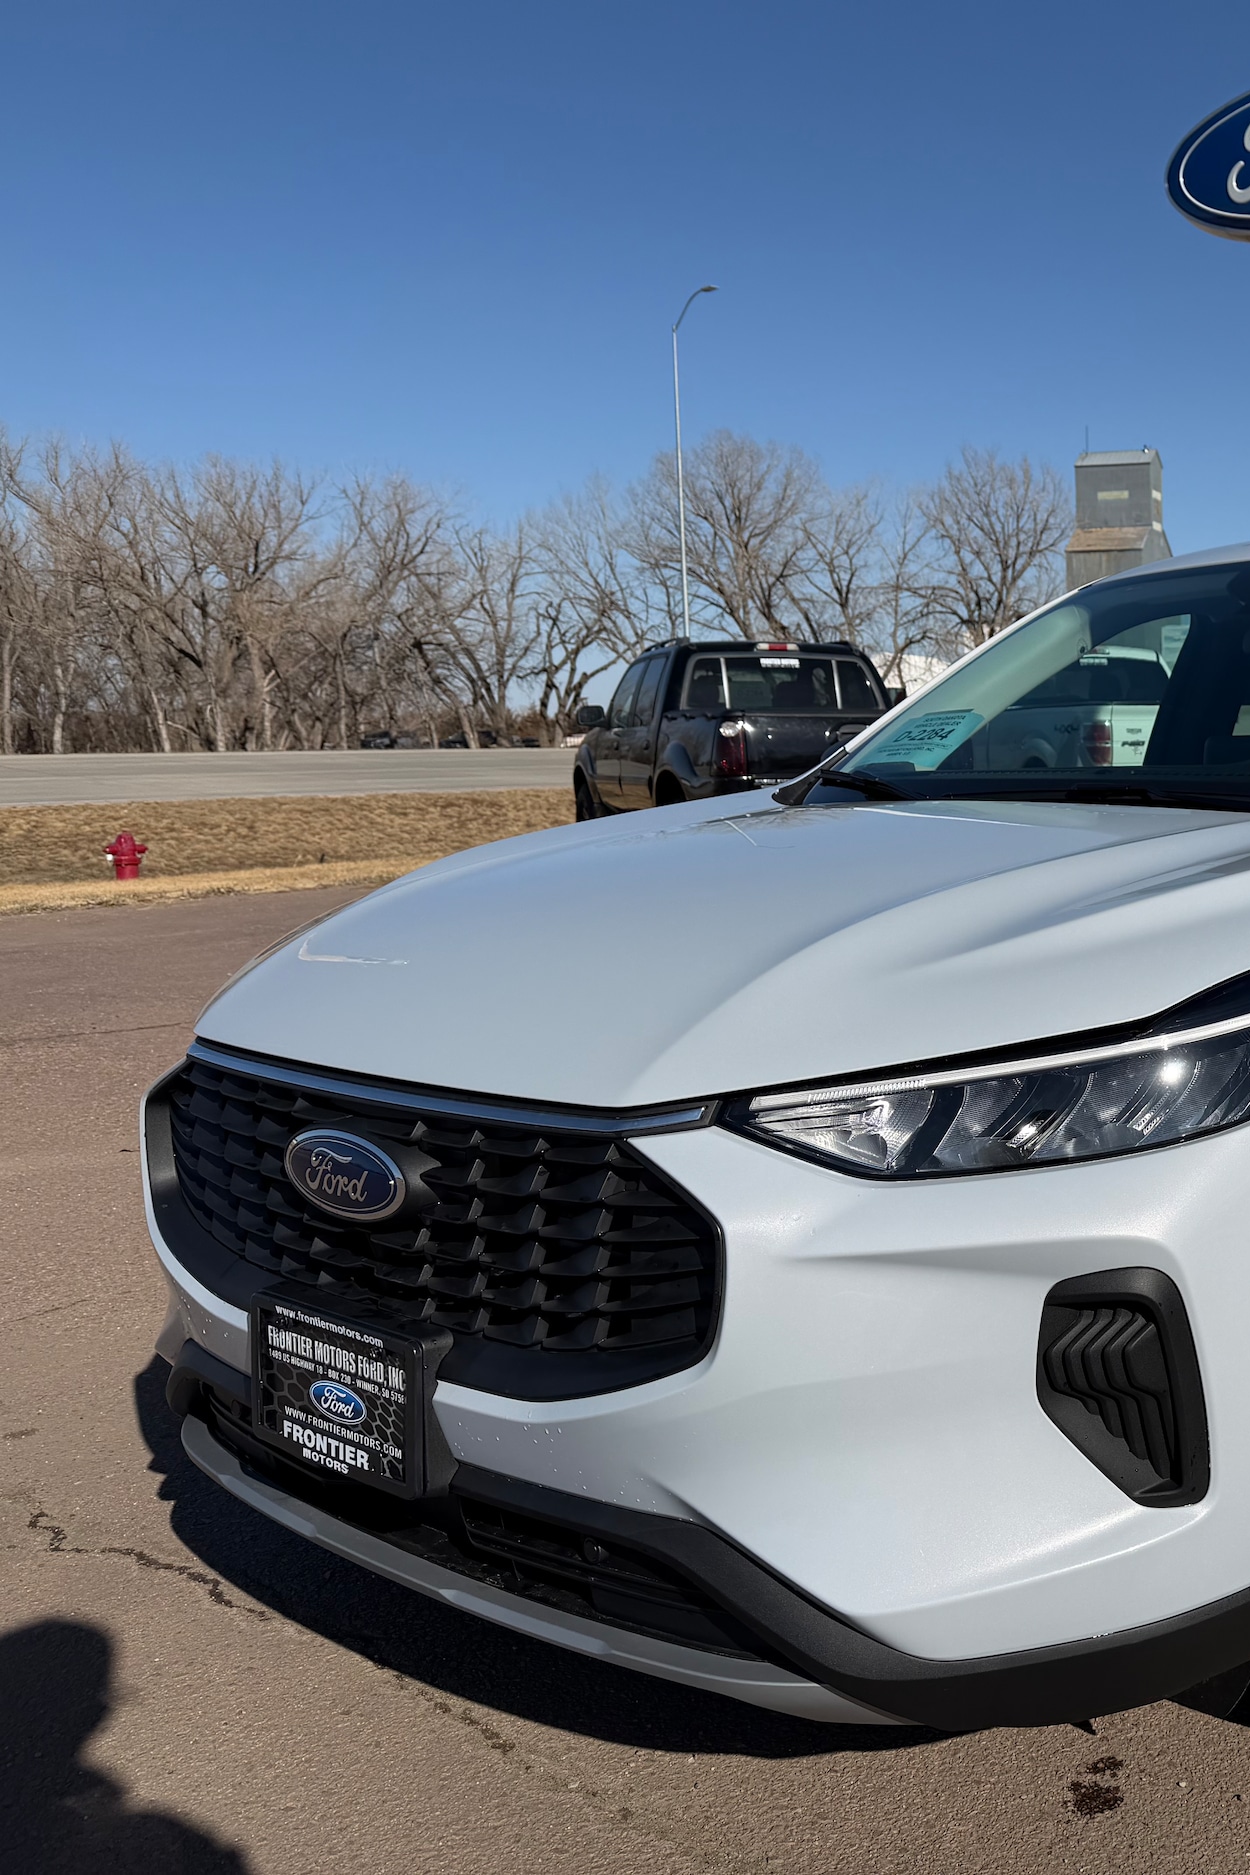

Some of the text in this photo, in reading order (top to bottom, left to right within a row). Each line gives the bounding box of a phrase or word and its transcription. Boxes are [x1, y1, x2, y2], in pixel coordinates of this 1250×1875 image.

[892, 727, 956, 743] D-2284
[305, 1147, 369, 1202] Ford
[274, 1304, 384, 1348] www.frontiermotors.com
[267, 1324, 313, 1360] FRONTIER
[314, 1340, 356, 1374] MOTORS
[357, 1353, 388, 1387] FORD,
[282, 1352, 291, 1364] US
[290, 1355, 316, 1373] HIGHWAY
[327, 1369, 340, 1382] BOX
[320, 1386, 355, 1419] Ford
[282, 1419, 370, 1471] FRONTIER
[284, 1405, 403, 1460] WWW.FRONTIERMOTORS.COM
[302, 1447, 350, 1475] MOTORS
